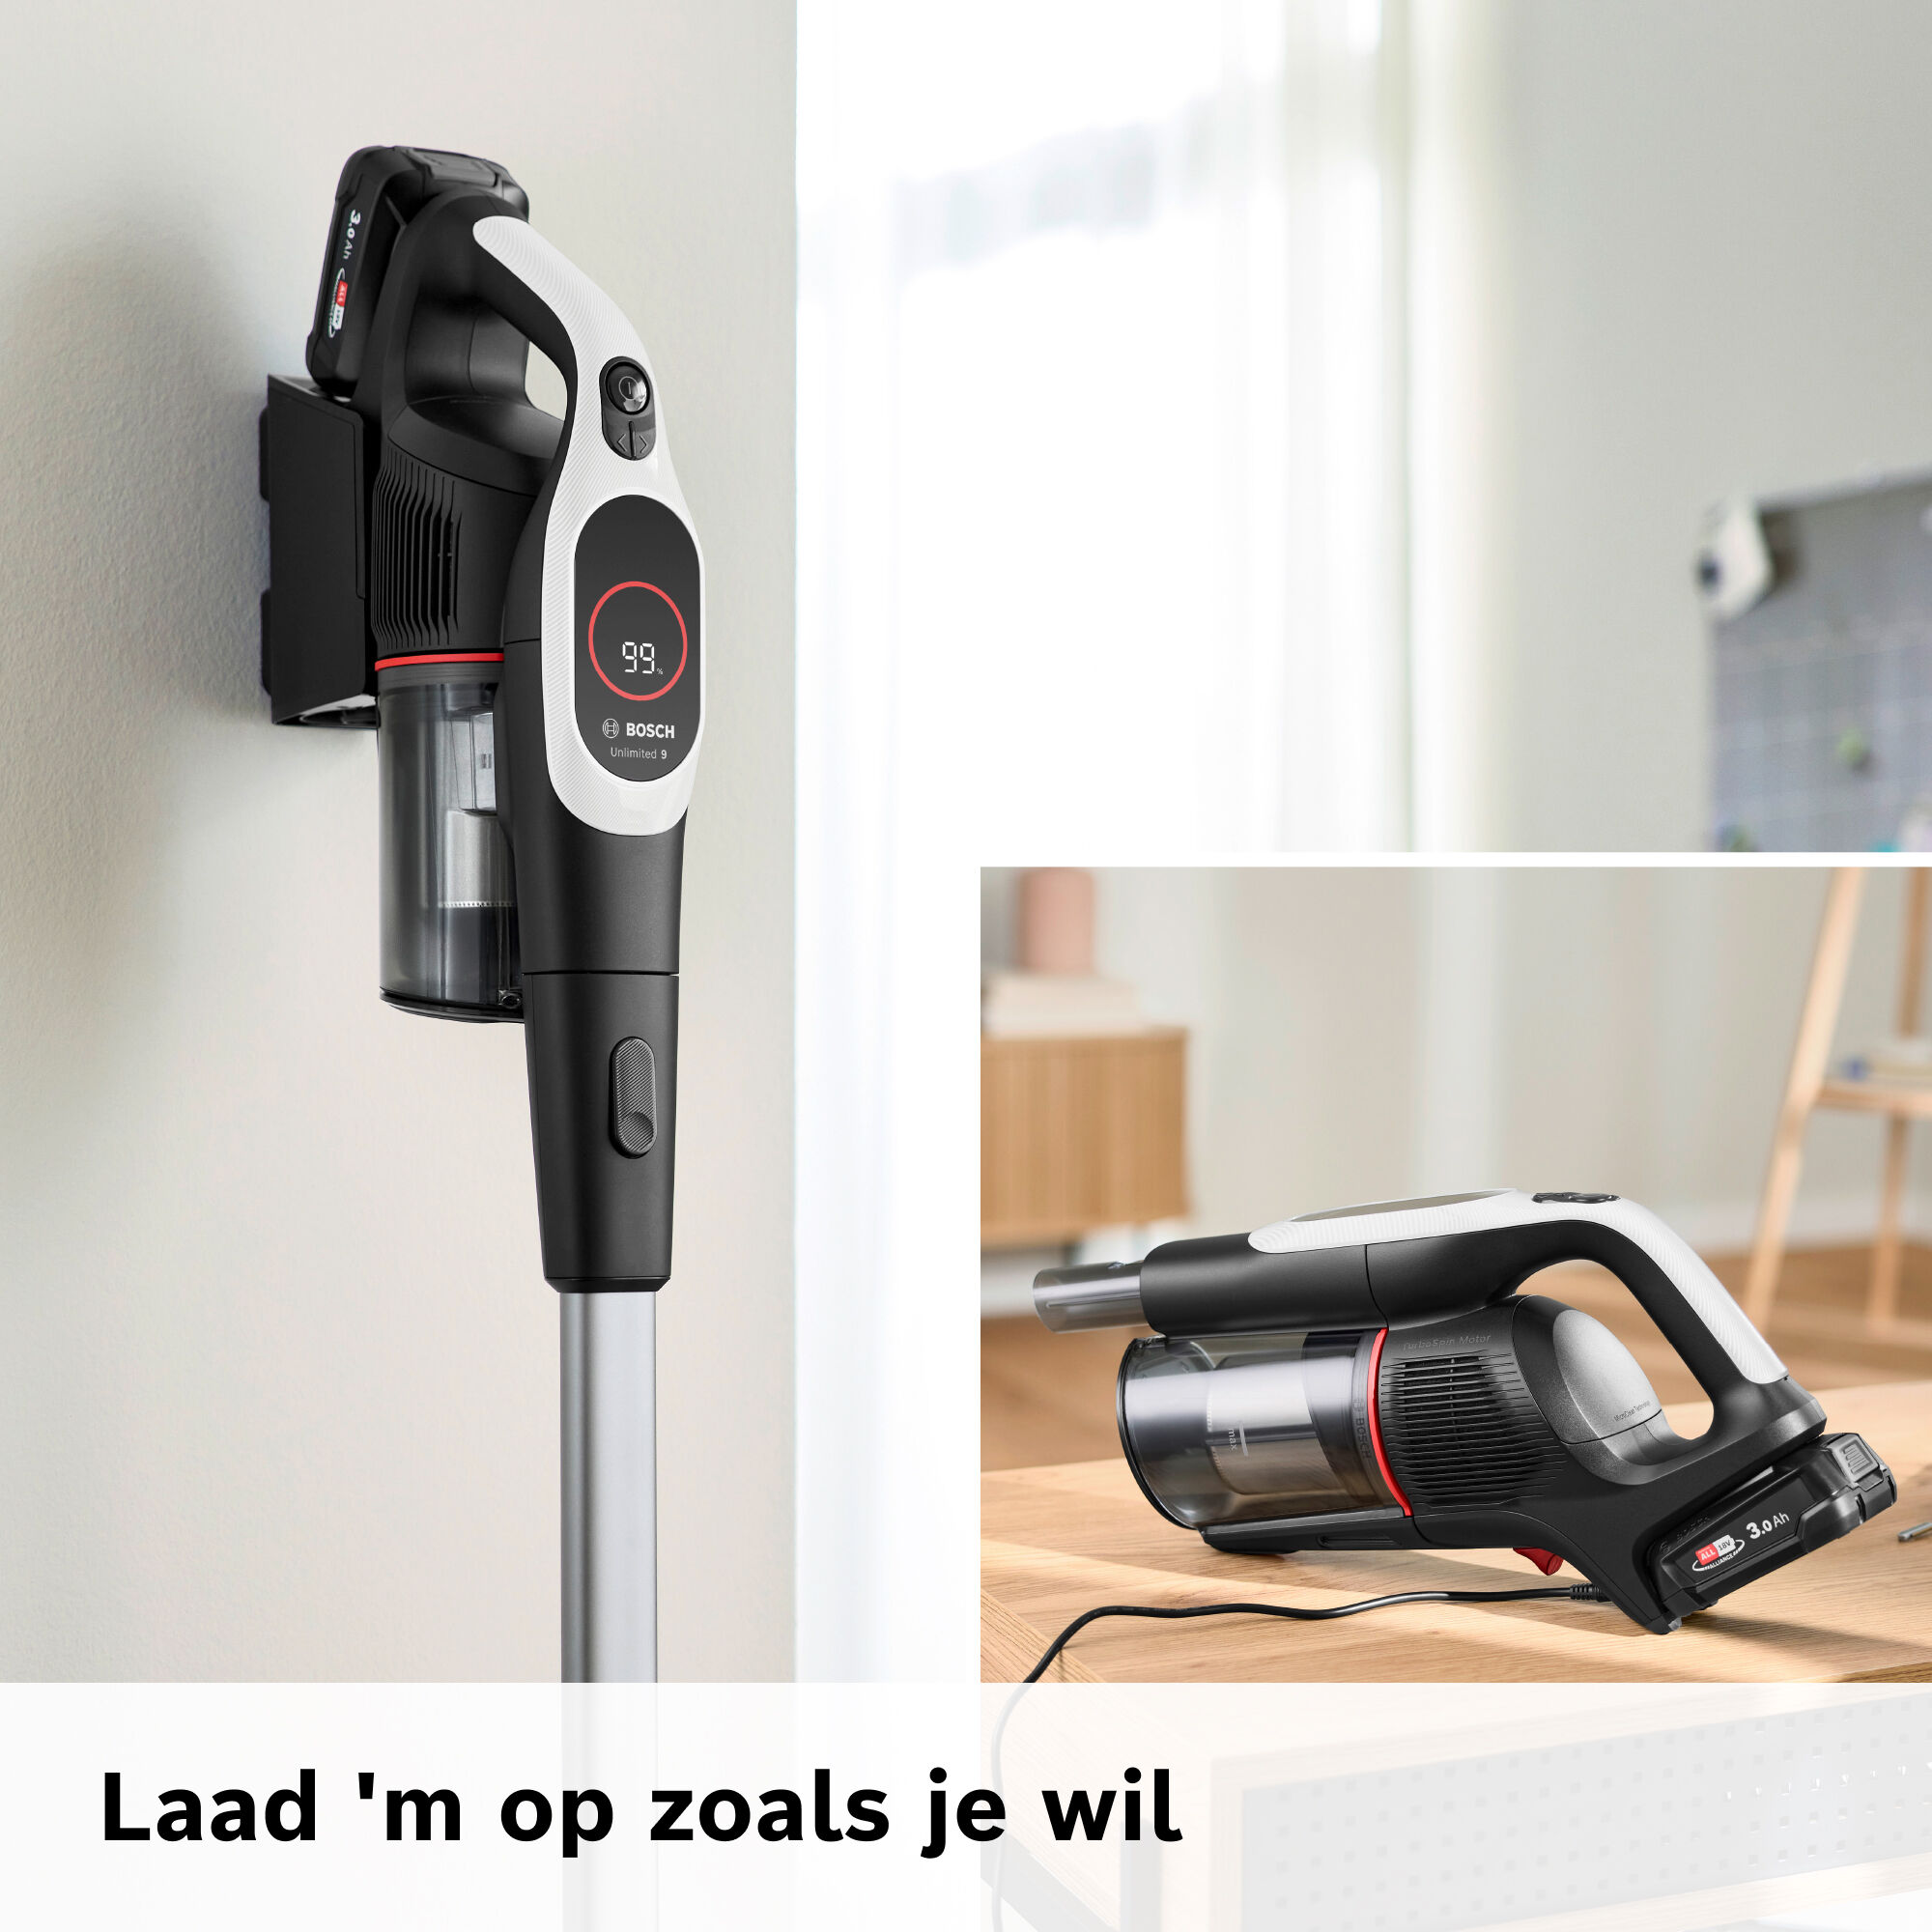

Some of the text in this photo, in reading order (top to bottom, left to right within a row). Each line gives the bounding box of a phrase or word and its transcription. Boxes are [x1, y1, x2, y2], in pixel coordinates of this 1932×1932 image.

[343, 209, 360, 259] 3.0 Ah
[626, 722, 675, 739] BOSCH
[610, 746, 668, 760] Unlimited 9
[1459, 1335, 1492, 1346] Motor
[1228, 1428, 1237, 1452] max
[1745, 1511, 1790, 1540] 3.0 Ah
[1718, 1539, 1732, 1551] 18V
[1700, 1548, 1716, 1561] ALL
[1709, 1552, 1735, 1570] ALLIANCE
